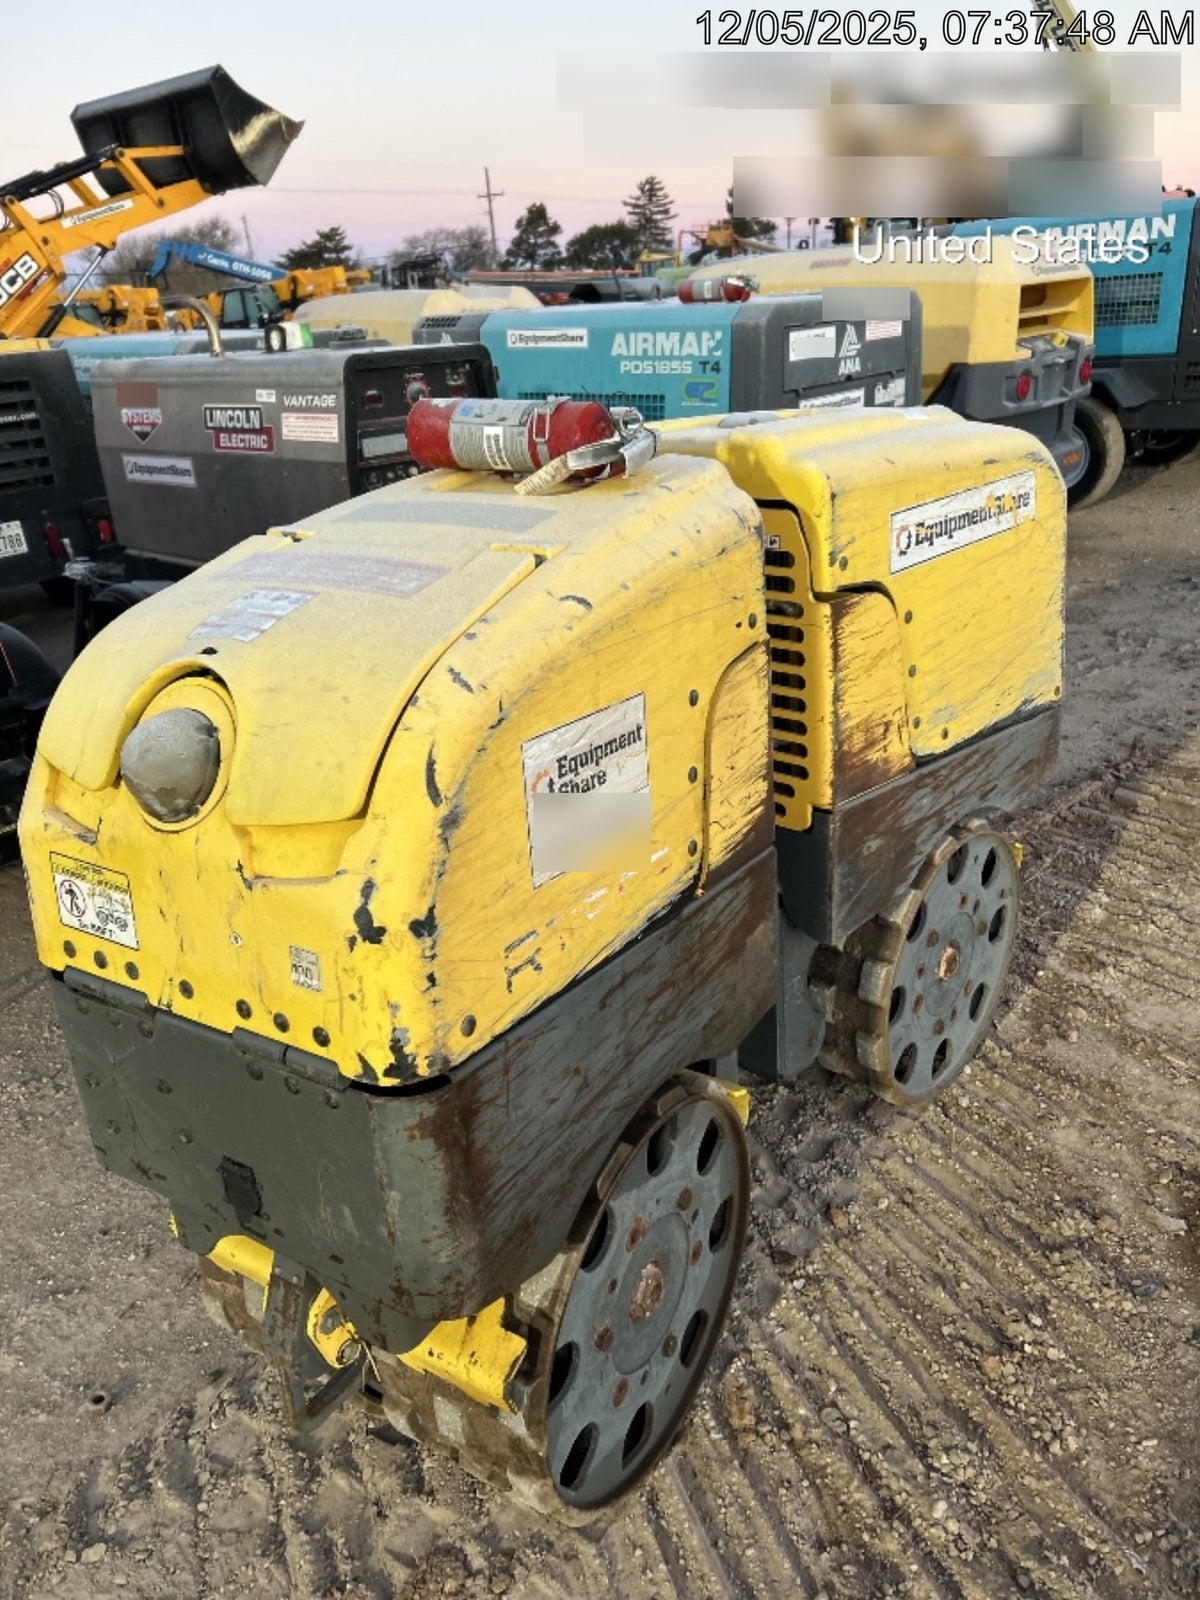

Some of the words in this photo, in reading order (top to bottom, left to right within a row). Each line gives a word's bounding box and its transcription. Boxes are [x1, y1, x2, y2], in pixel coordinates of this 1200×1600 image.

[610, 330, 723, 357] AIRMAN
[698, 360, 722, 375] T4
[838, 356, 862, 376] ANA
[283, 394, 337, 408] VANTAGE
[205, 408, 261, 430] LINCOLN
[219, 433, 269, 449] ELECTRIC
[914, 491, 1031, 547] Equipmentre
[556, 723, 643, 780] Equipment
